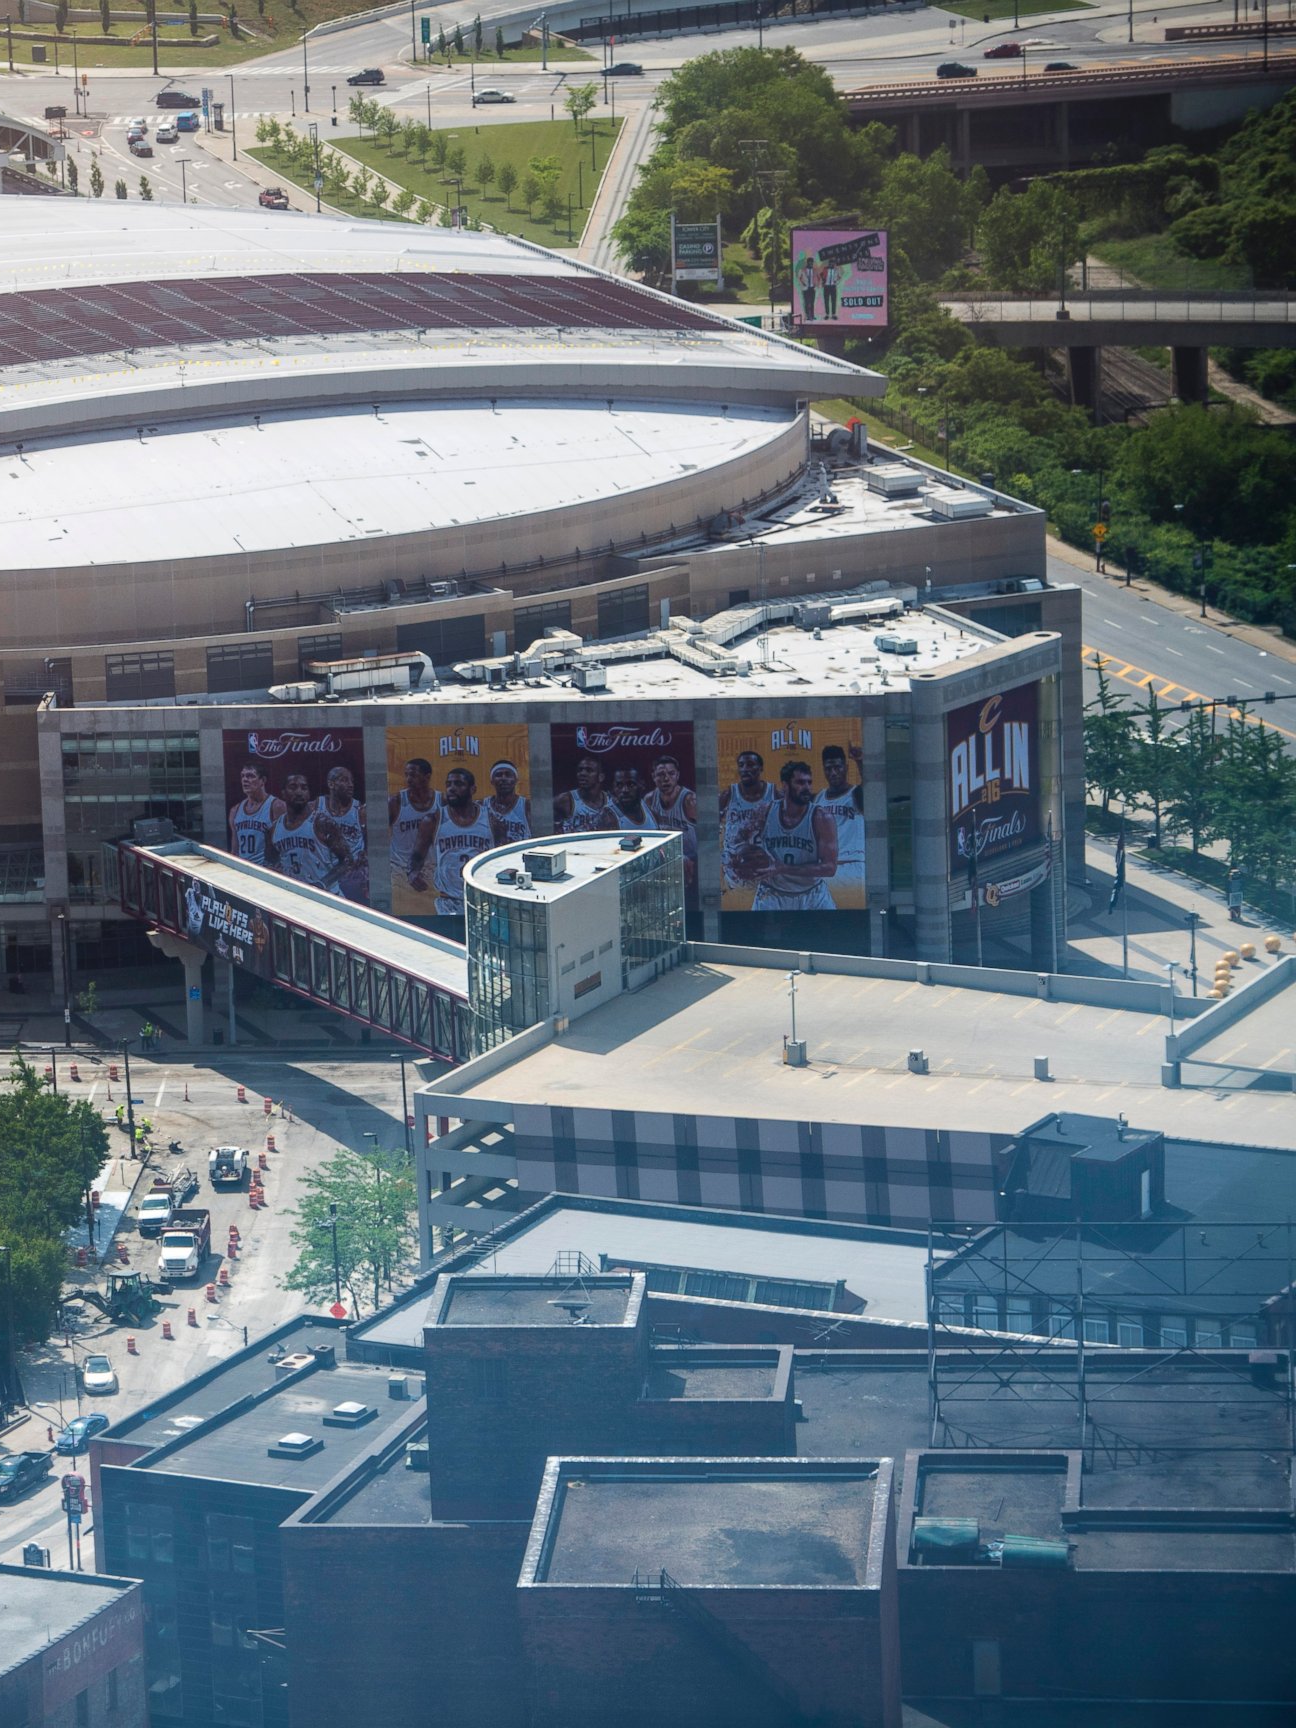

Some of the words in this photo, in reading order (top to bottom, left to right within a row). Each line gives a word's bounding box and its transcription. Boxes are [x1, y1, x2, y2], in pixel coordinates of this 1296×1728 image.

[844, 297, 863, 306] SOLD
[866, 297, 881, 305] OUT
[279, 732, 342, 753] Finals
[439, 735, 464, 756] ALL
[465, 735, 479, 756] IN
[608, 726, 673, 748] Finals
[771, 729, 795, 750] ALL
[798, 729, 812, 749] IN
[952, 731, 1001, 817] ALL
[1004, 722, 1030, 789] IN
[979, 810, 1026, 846] Finals
[240, 834, 256, 854] 20
[273, 836, 316, 851] CAVALIERS
[438, 834, 490, 853] CAVALIERS
[766, 836, 814, 853] CAVALIERS
[289, 853, 301, 874] 5
[1001, 881, 1020, 892] Quicken
[202, 895, 249, 929] PLAYOFFS
[209, 914, 229, 934] LIVE
[229, 924, 253, 945] HERE
